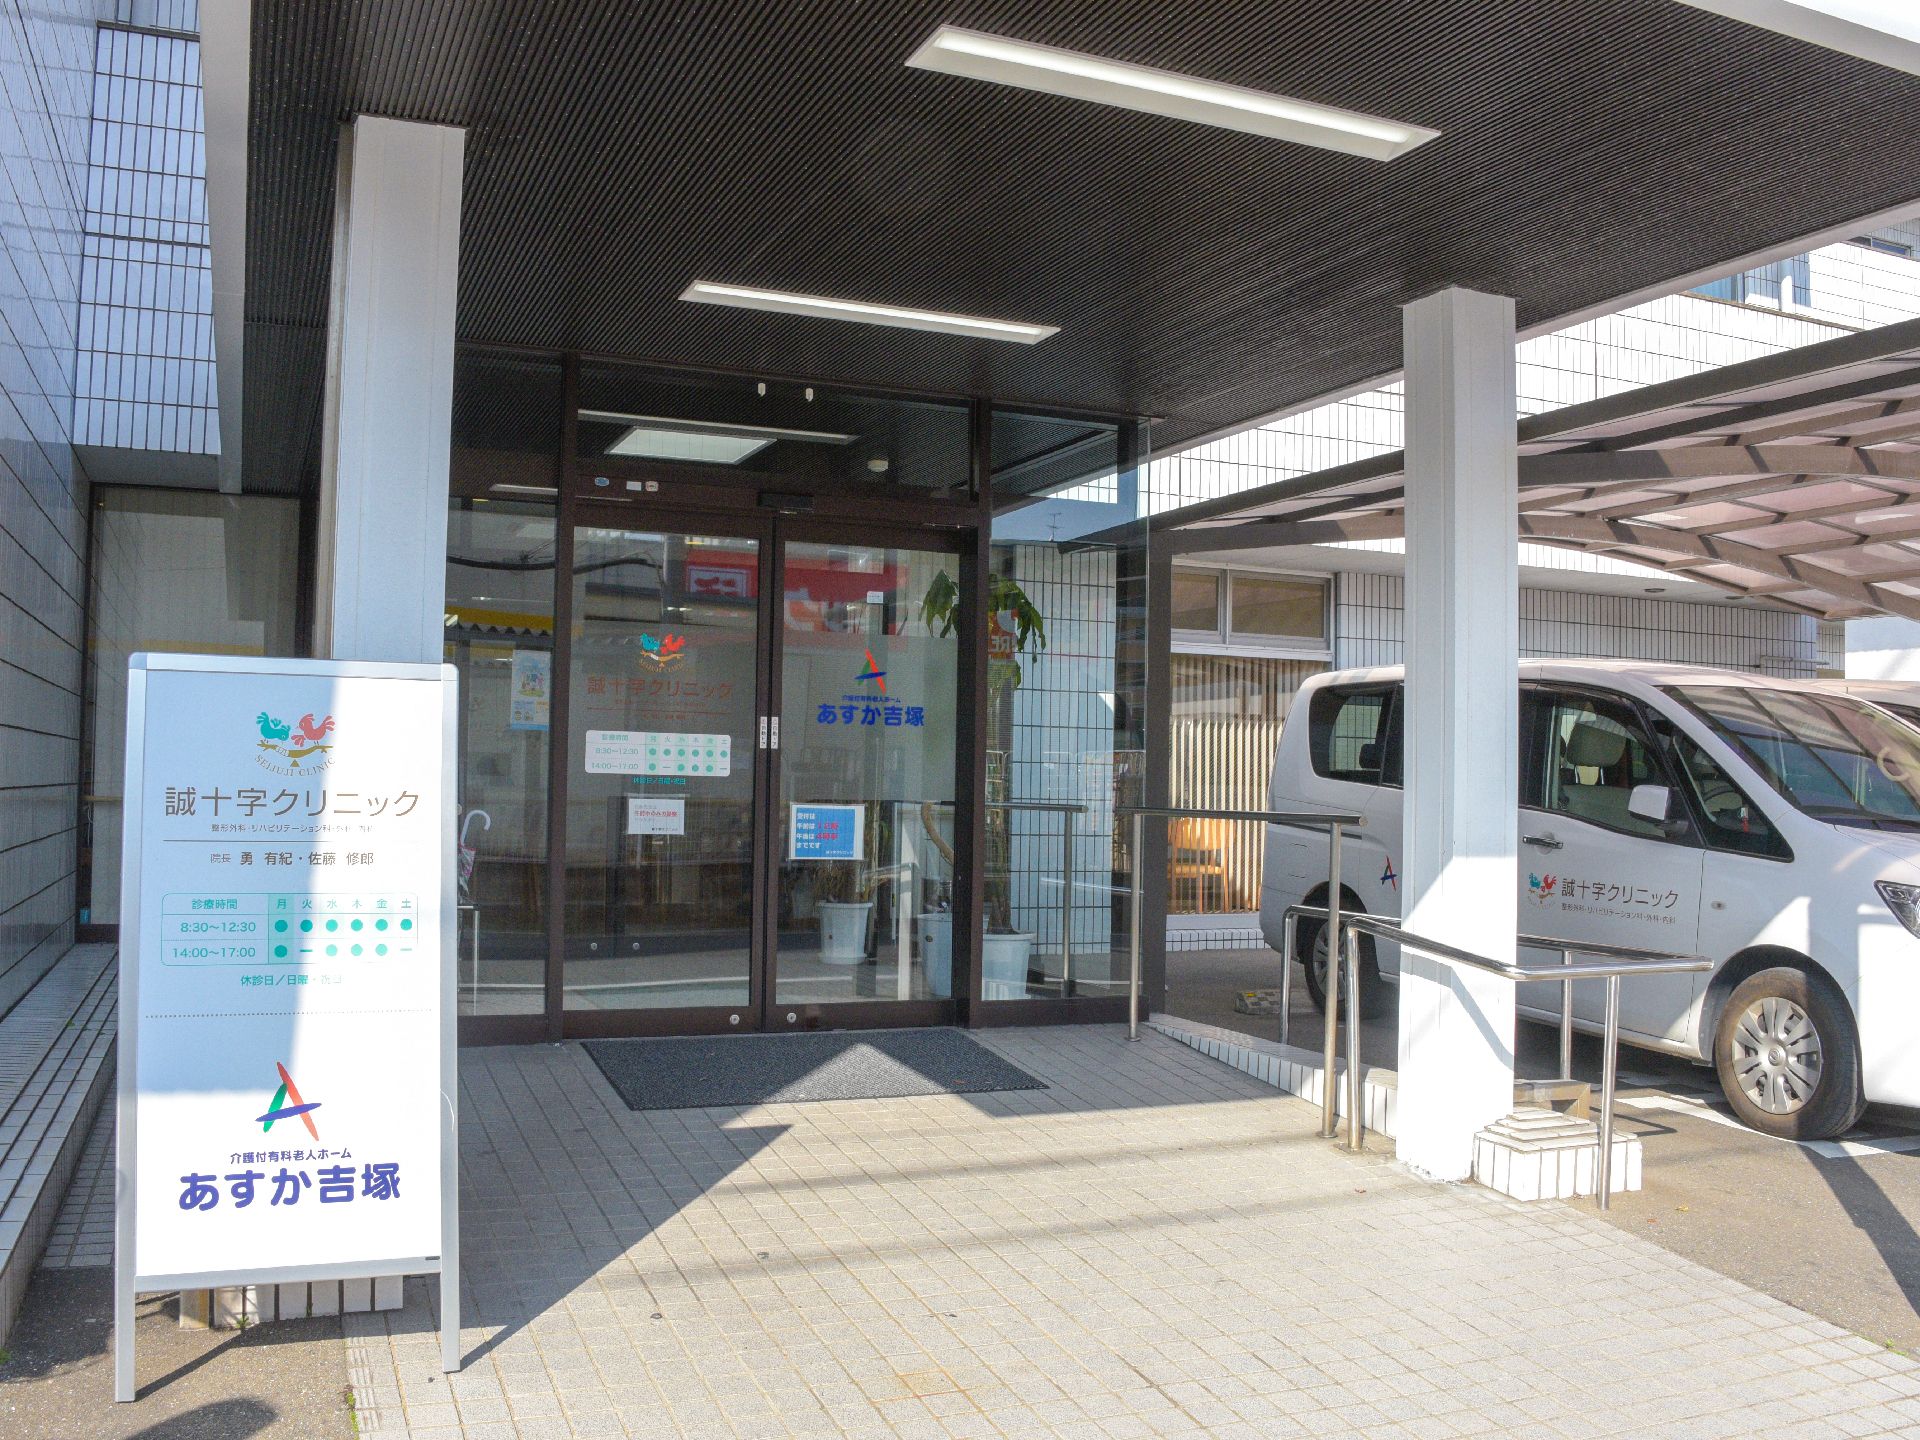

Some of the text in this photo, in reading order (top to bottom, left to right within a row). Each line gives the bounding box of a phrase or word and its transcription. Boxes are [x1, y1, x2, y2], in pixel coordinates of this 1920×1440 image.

[586, 675, 734, 699] 誠十字クリニック
[816, 703, 925, 726] あすか吉塚
[298, 757, 336, 777] CLINIC
[165, 786, 419, 818] 誠十字クリニック
[210, 853, 232, 864] 院長
[240, 851, 254, 866] 勇
[346, 851, 375, 866] 修郎
[191, 898, 412, 911] 診療時間 月 火 水 木 金 土
[1561, 878, 1679, 909] 誠十字クリニック
[230, 1147, 352, 1164] 介護付有料老人ホーム
[178, 1162, 401, 1212] あすか吉塚
